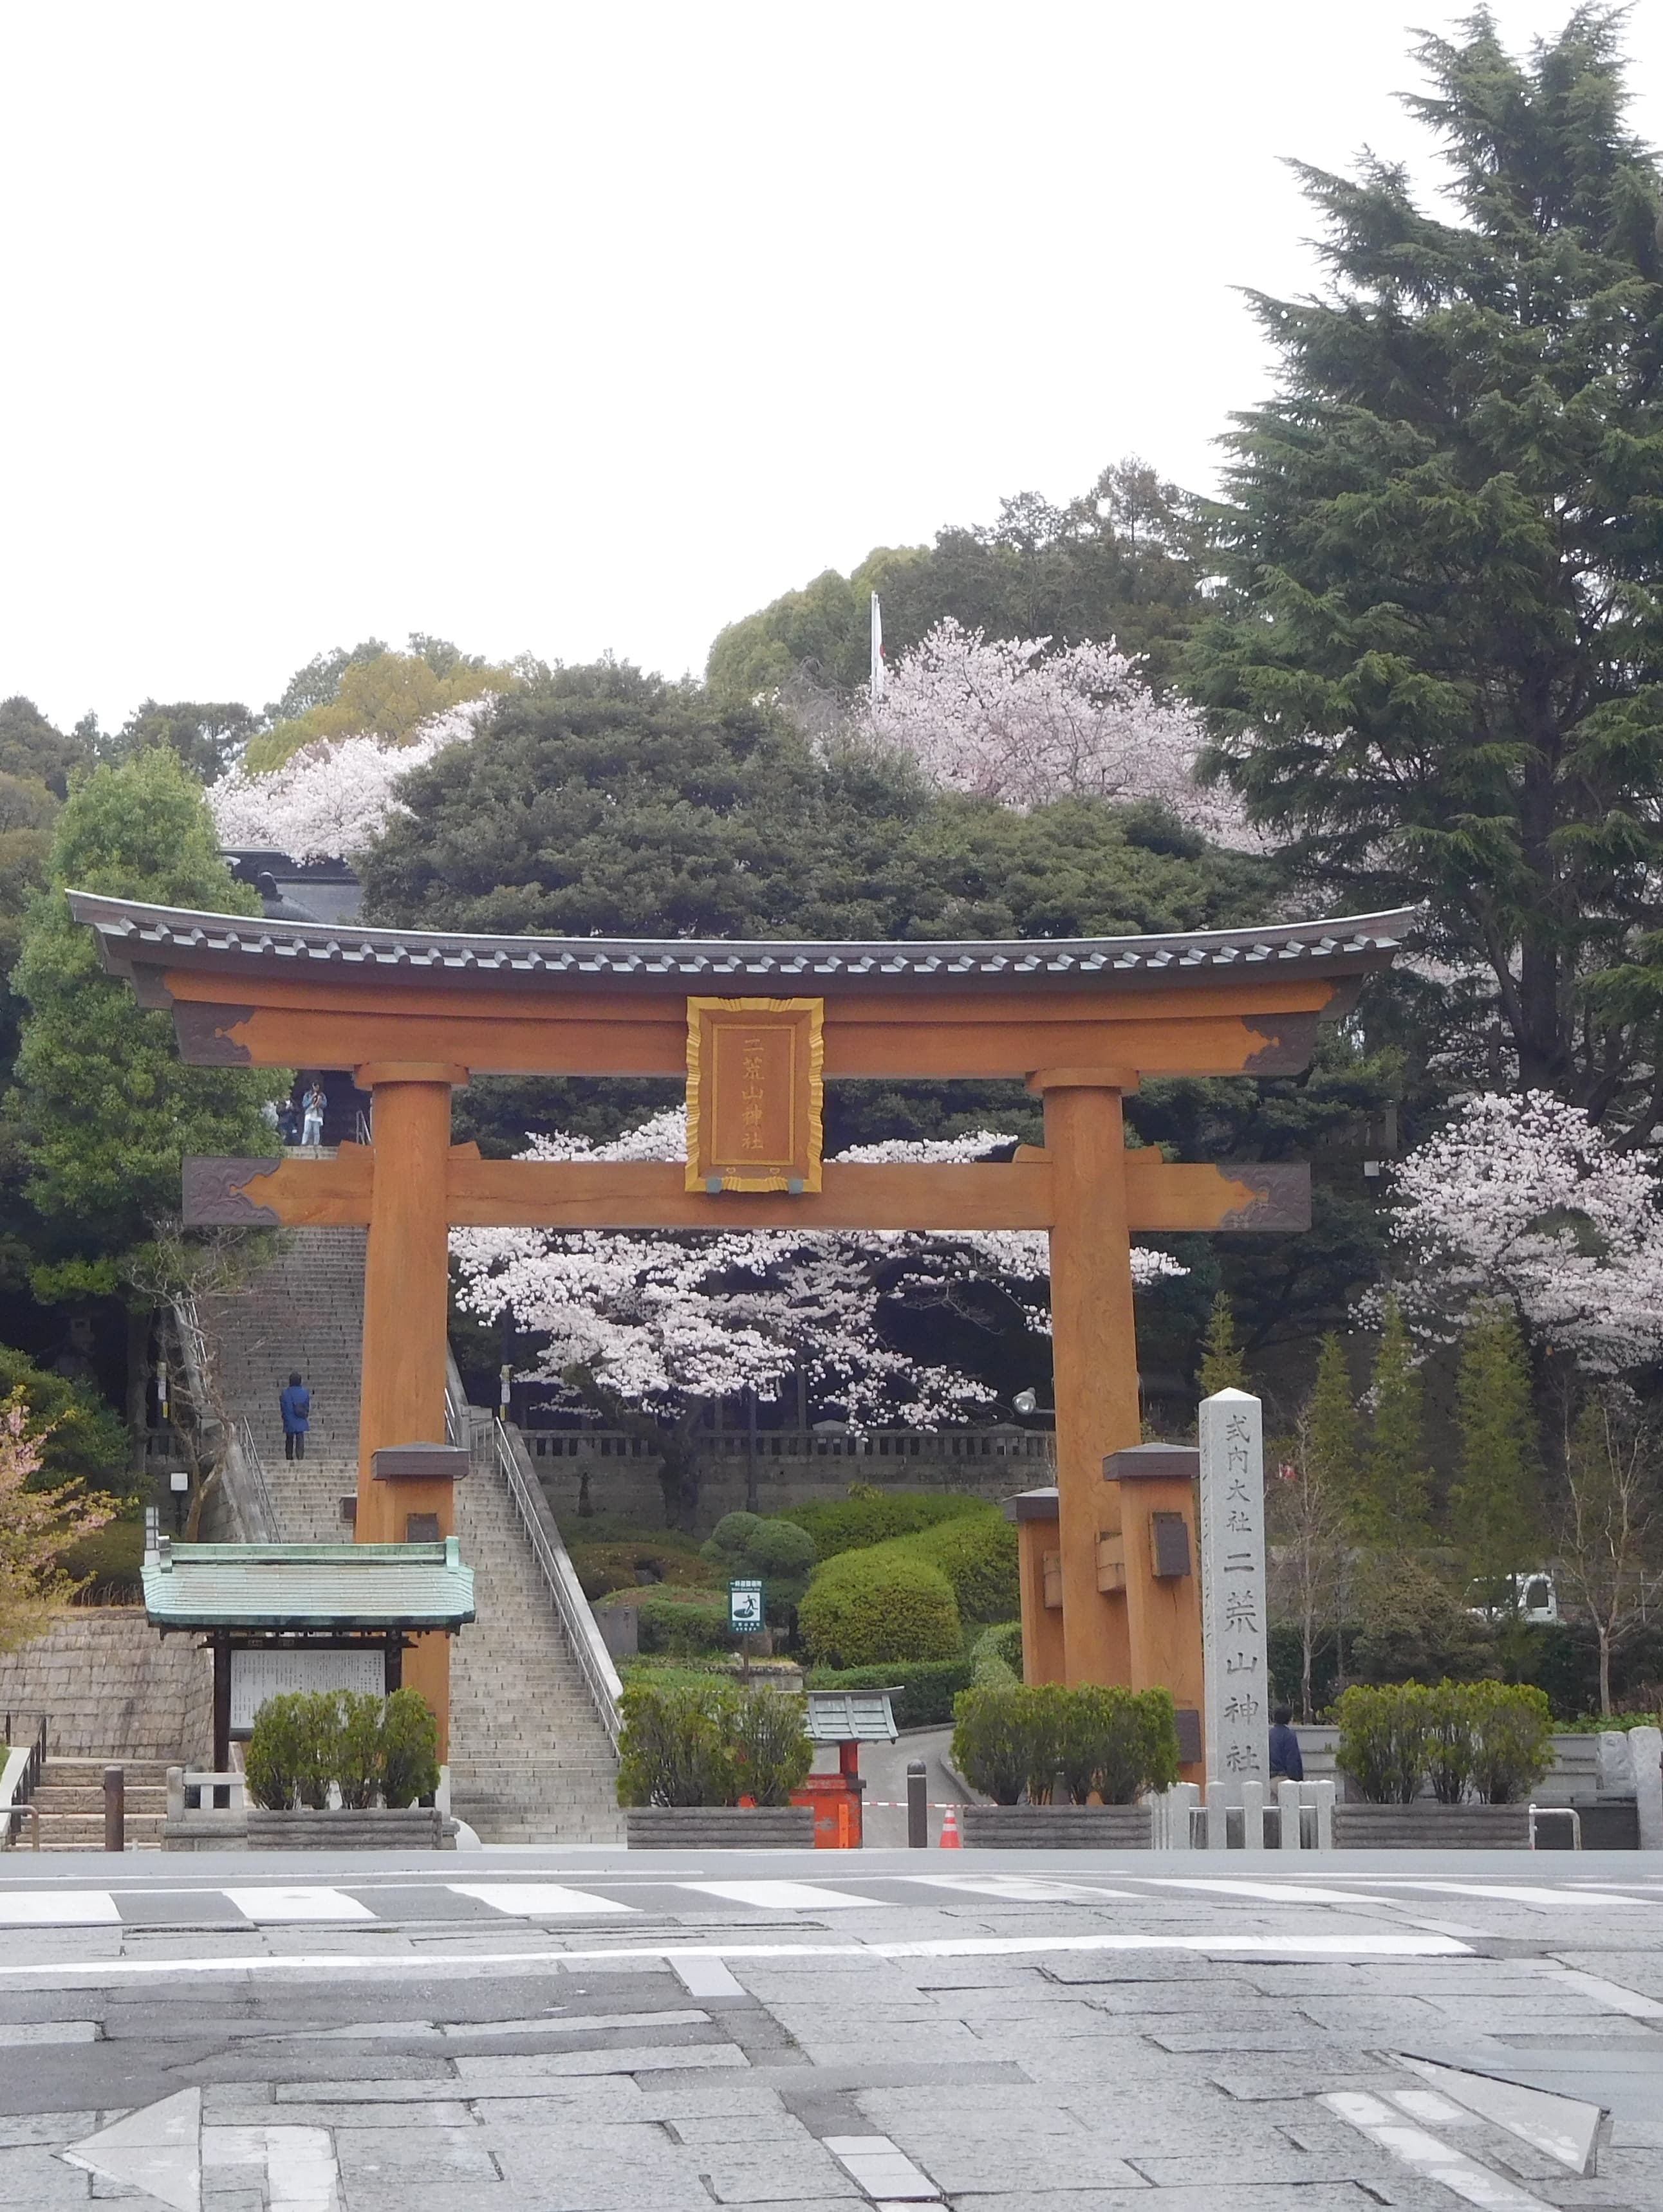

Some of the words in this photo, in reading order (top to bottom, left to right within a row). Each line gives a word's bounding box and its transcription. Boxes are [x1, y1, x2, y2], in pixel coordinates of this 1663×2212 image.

[742, 1038, 765, 1150] 二荒山神社
